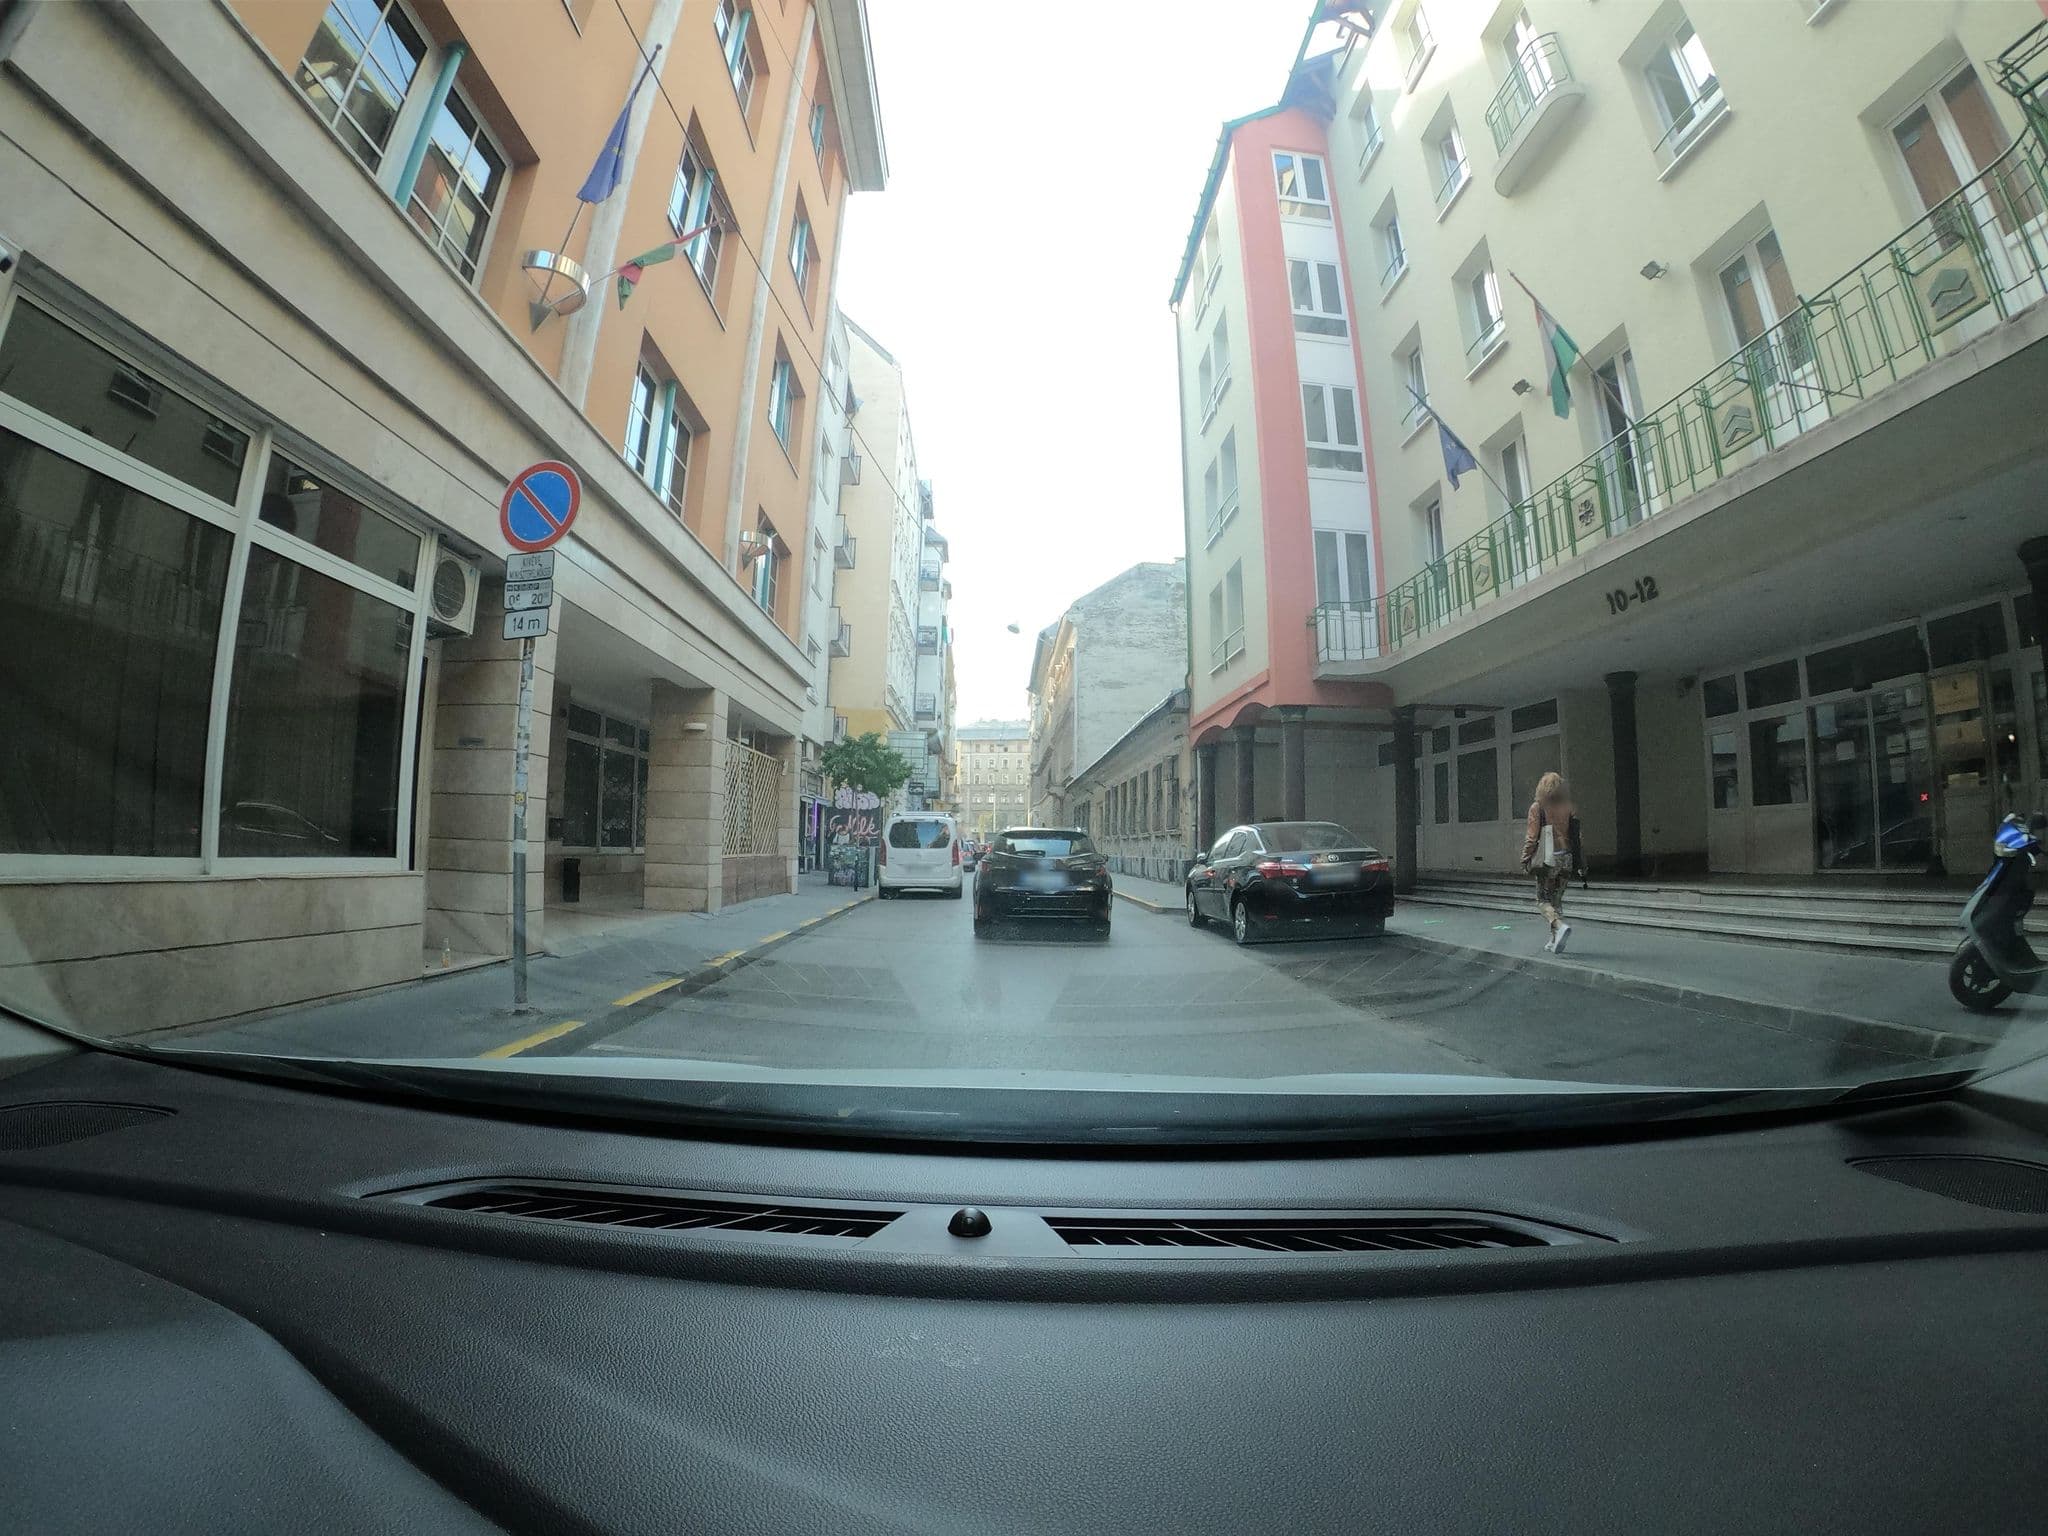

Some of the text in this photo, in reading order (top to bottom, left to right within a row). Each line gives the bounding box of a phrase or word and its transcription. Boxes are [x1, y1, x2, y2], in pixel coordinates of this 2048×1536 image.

[1606, 576, 1659, 615] 10-12
[513, 616, 540, 632] 14 m
